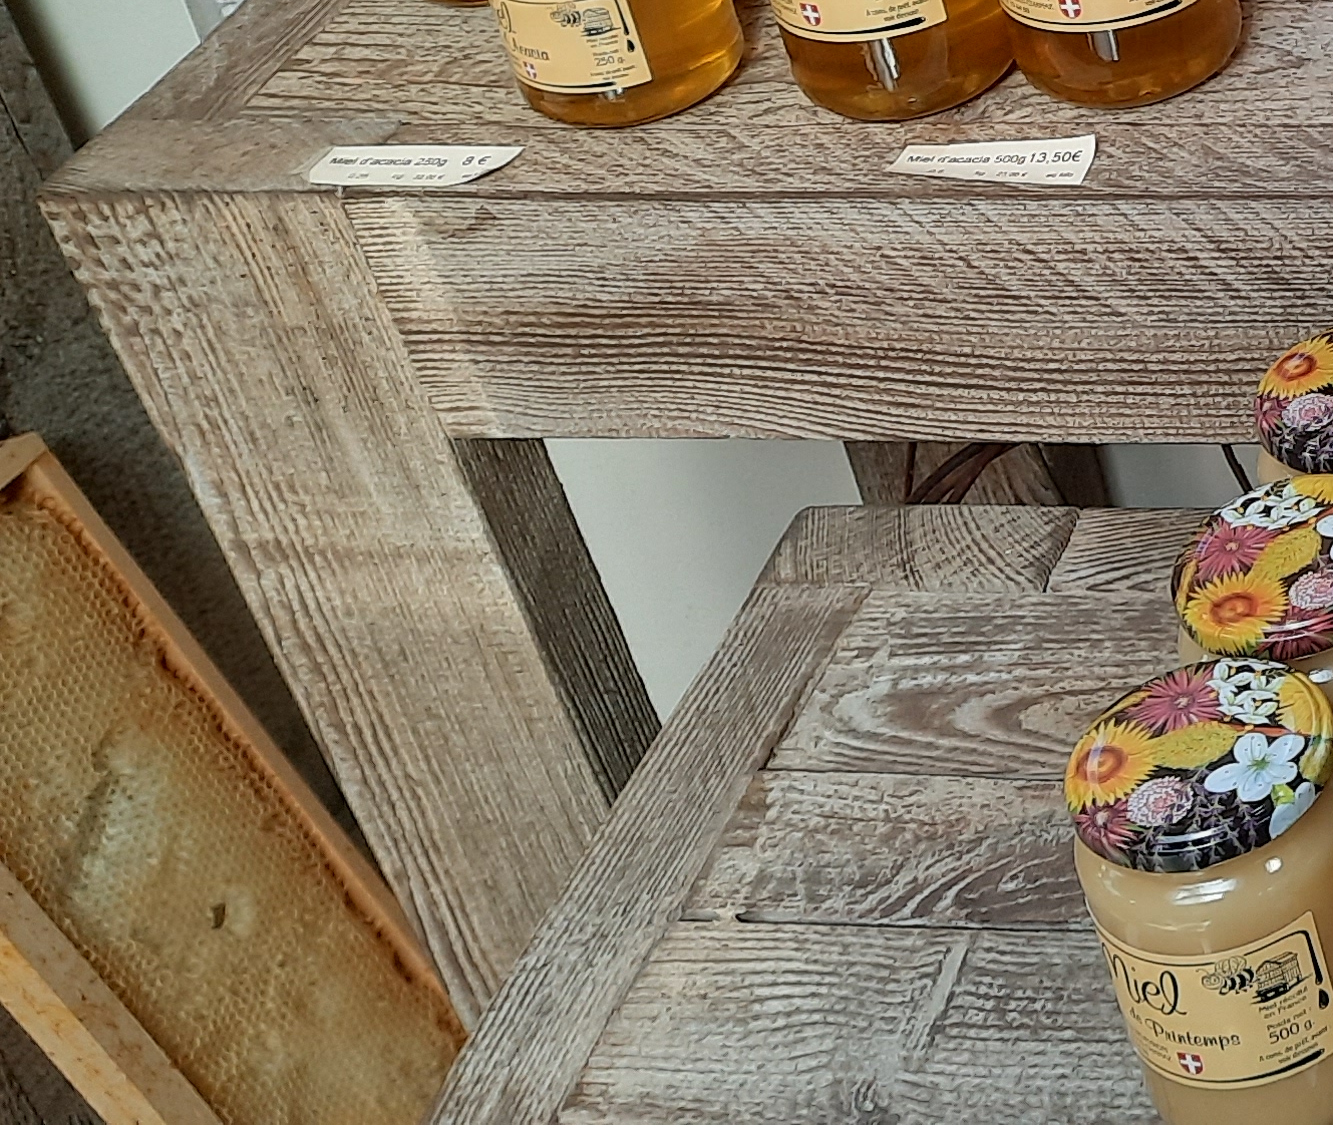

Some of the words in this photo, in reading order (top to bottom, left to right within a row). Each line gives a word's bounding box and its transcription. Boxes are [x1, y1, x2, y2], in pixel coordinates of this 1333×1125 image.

[329, 157, 358, 166] Miel
[462, 155, 475, 166] 8
[478, 155, 492, 165] €
[906, 154, 934, 163] Miel
[993, 154, 1028, 166] 500g
[1029, 149, 1083, 165] 13,50€
[1144, 1017, 1242, 1051] Printemps
[1268, 1021, 1300, 1045] 500
